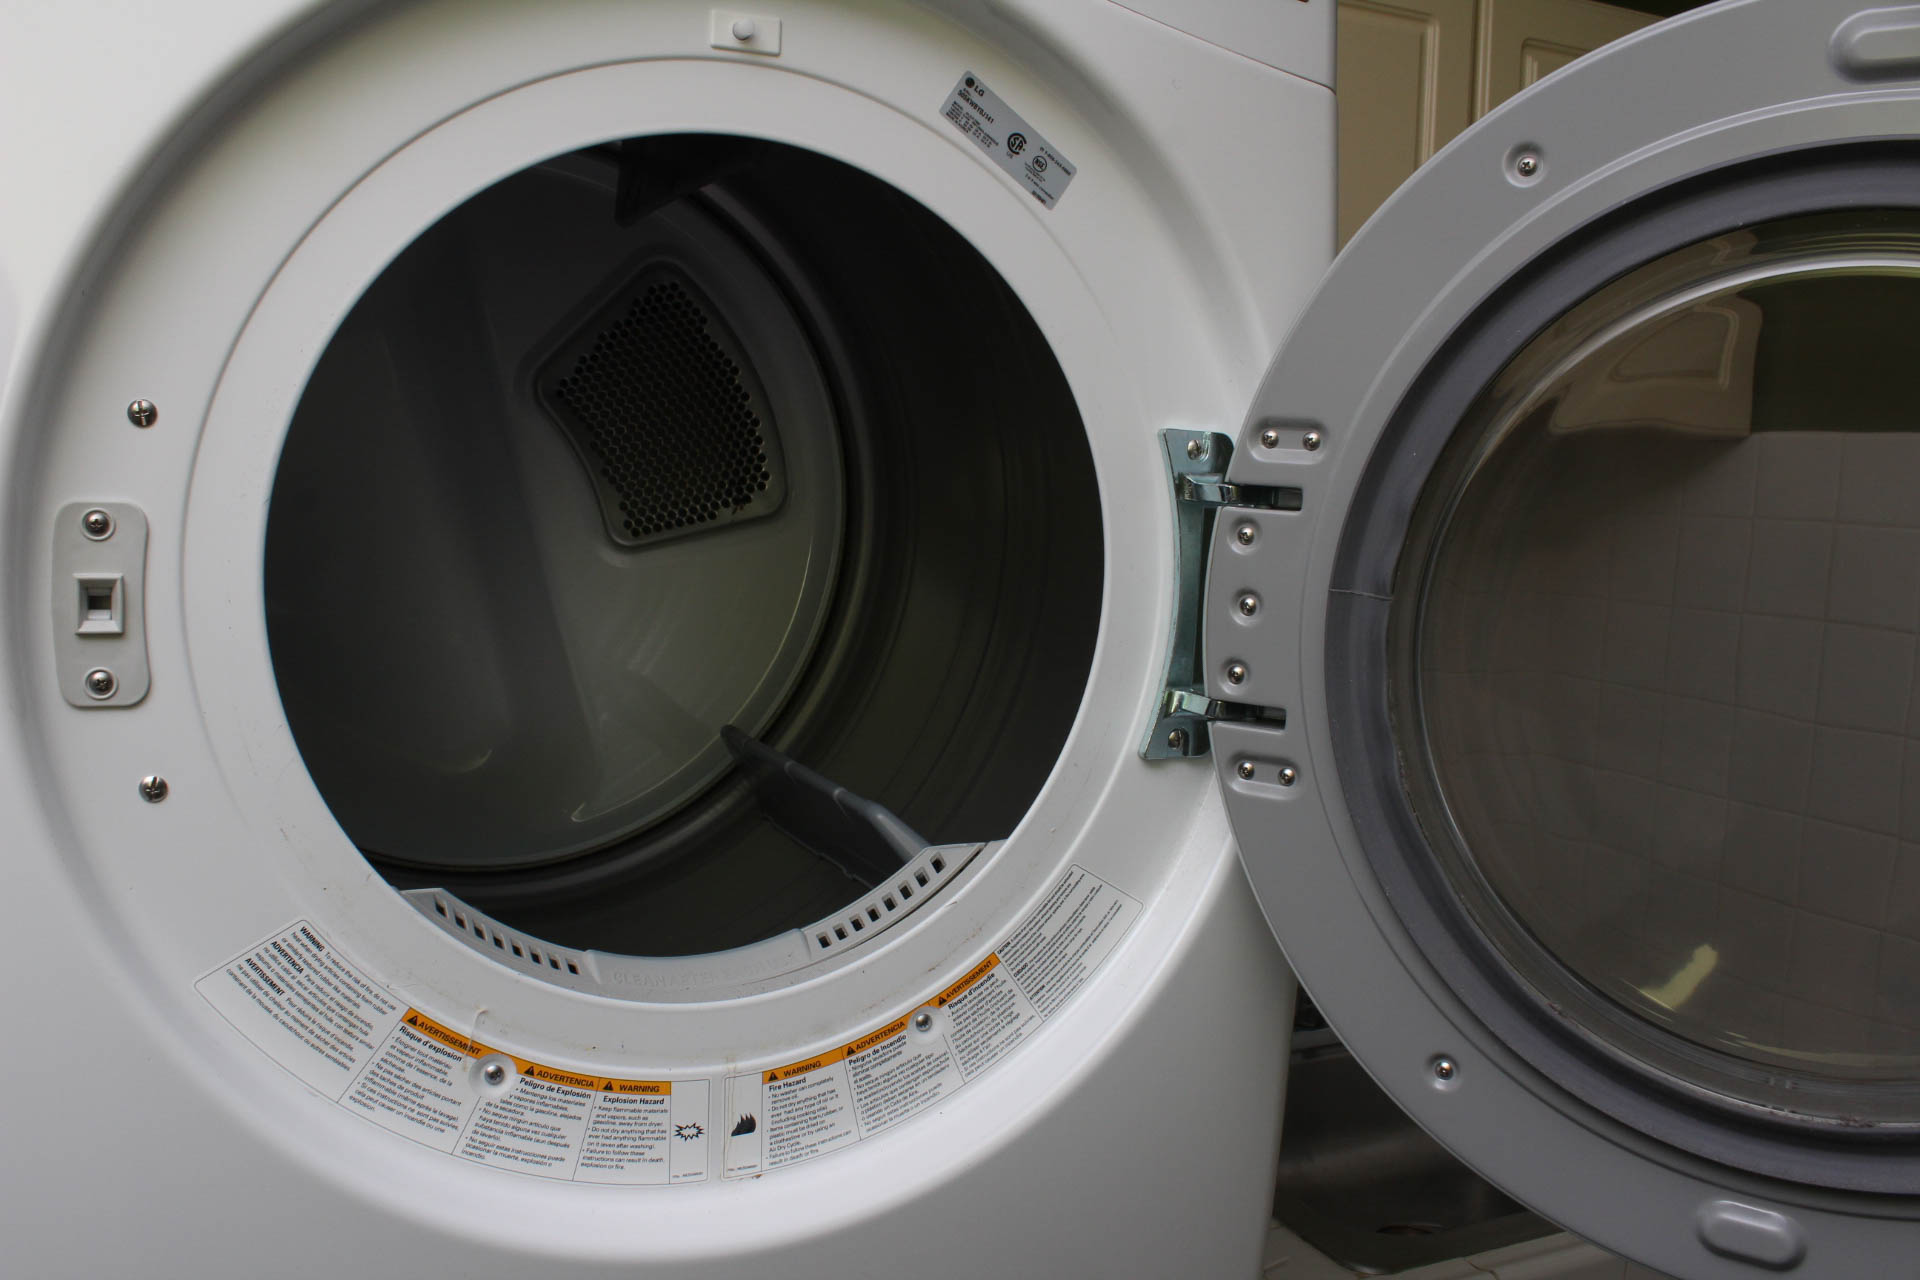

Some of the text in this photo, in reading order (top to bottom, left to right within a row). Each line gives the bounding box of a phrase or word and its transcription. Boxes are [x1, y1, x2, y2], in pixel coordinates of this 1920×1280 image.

[973, 84, 985, 97] LG
[271, 941, 303, 974] ADVERTENCIA
[300, 926, 324, 952] WARNING
[329, 958, 345, 972] reduce
[344, 970, 353, 979] the
[351, 976, 361, 985] risk
[245, 958, 284, 996] AVERTISSEMENT
[946, 960, 992, 998] AVERTISSEMENT
[947, 994, 968, 1010] Risque
[399, 1025, 422, 1043] Risque
[418, 1022, 481, 1054] AVERTISSEMENT
[856, 1021, 905, 1050] ADVERTENCIA
[848, 1034, 906, 1066] Peligro de Incendio
[536, 1070, 594, 1087] ADVERTENCIA
[783, 1060, 821, 1077] WARNING
[519, 1077, 591, 1099] Peligro de Explosión
[619, 1084, 660, 1093] WARNING
[768, 1076, 806, 1092] Fire Hazard
[603, 1095, 665, 1105] Explosion Hazard
